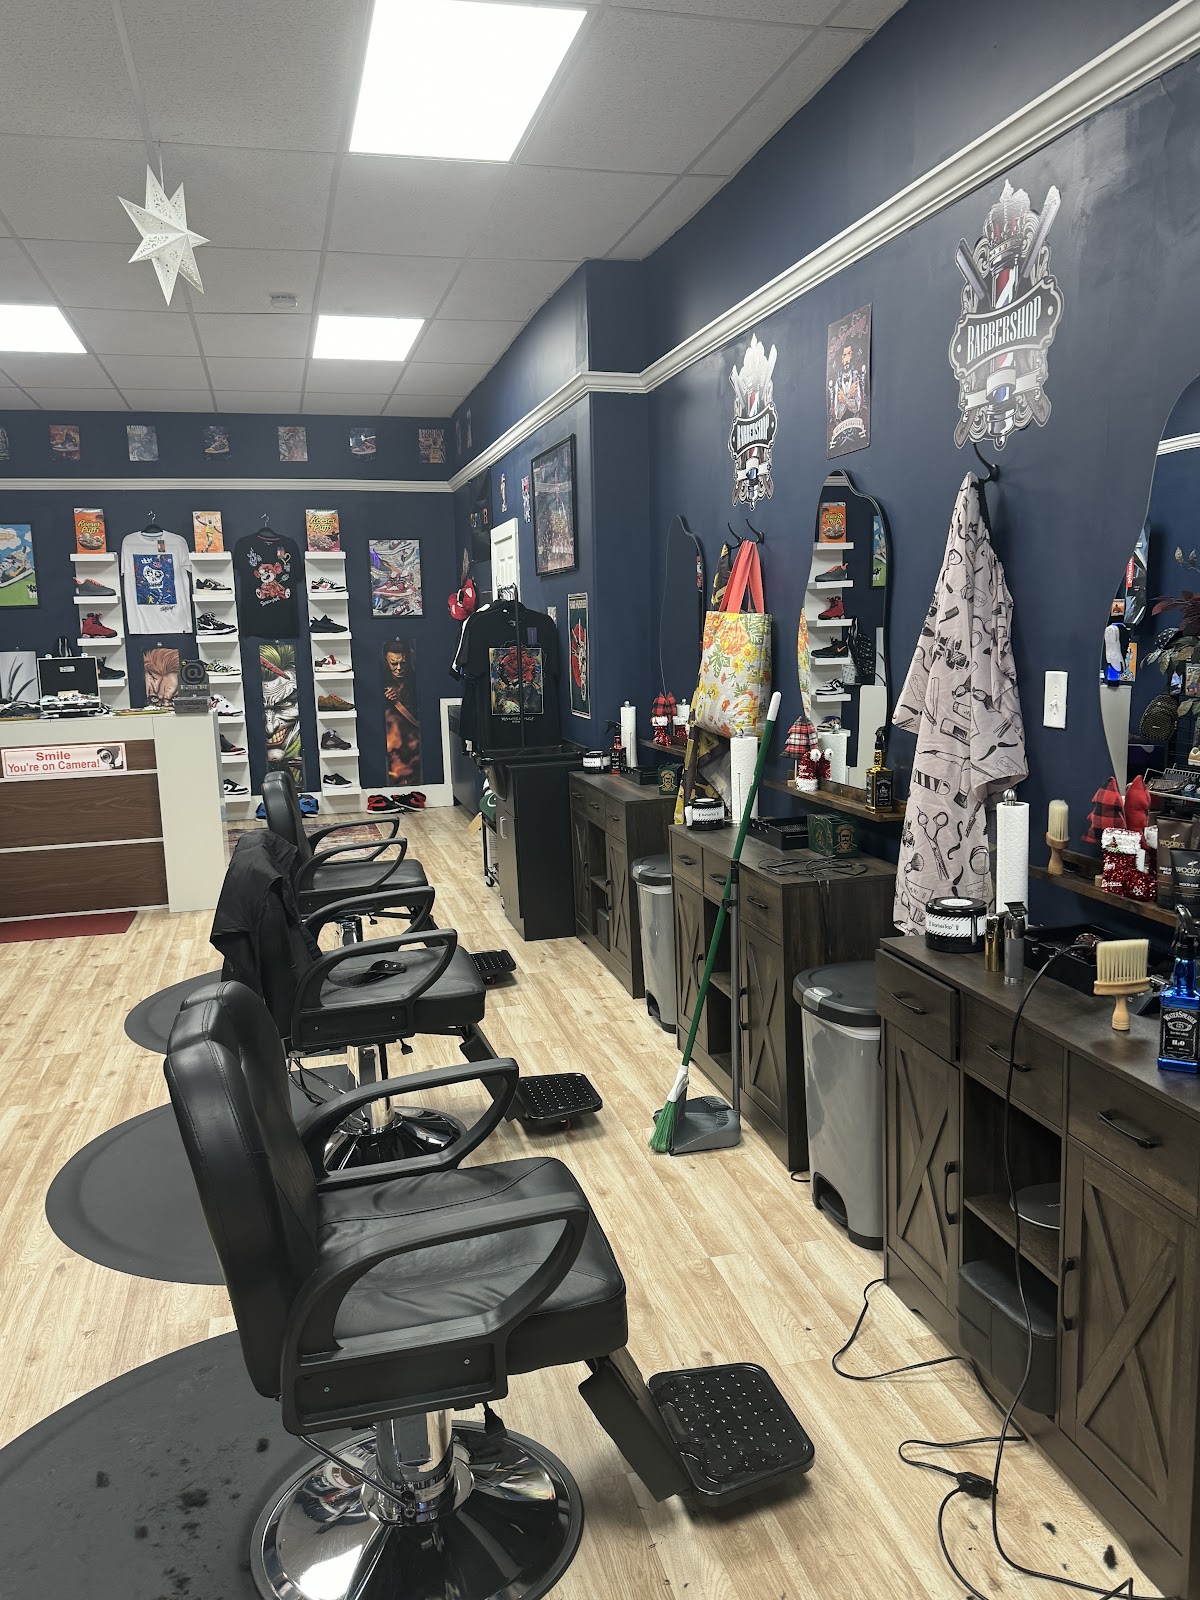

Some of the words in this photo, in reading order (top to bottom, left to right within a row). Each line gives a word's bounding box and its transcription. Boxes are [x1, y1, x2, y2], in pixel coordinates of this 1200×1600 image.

[966, 295, 1042, 364] BARBERSHOP
[35, 751, 71, 761] Smile
[7, 763, 39, 773] You're
[42, 763, 55, 771] on
[58, 759, 100, 770] Camera!
